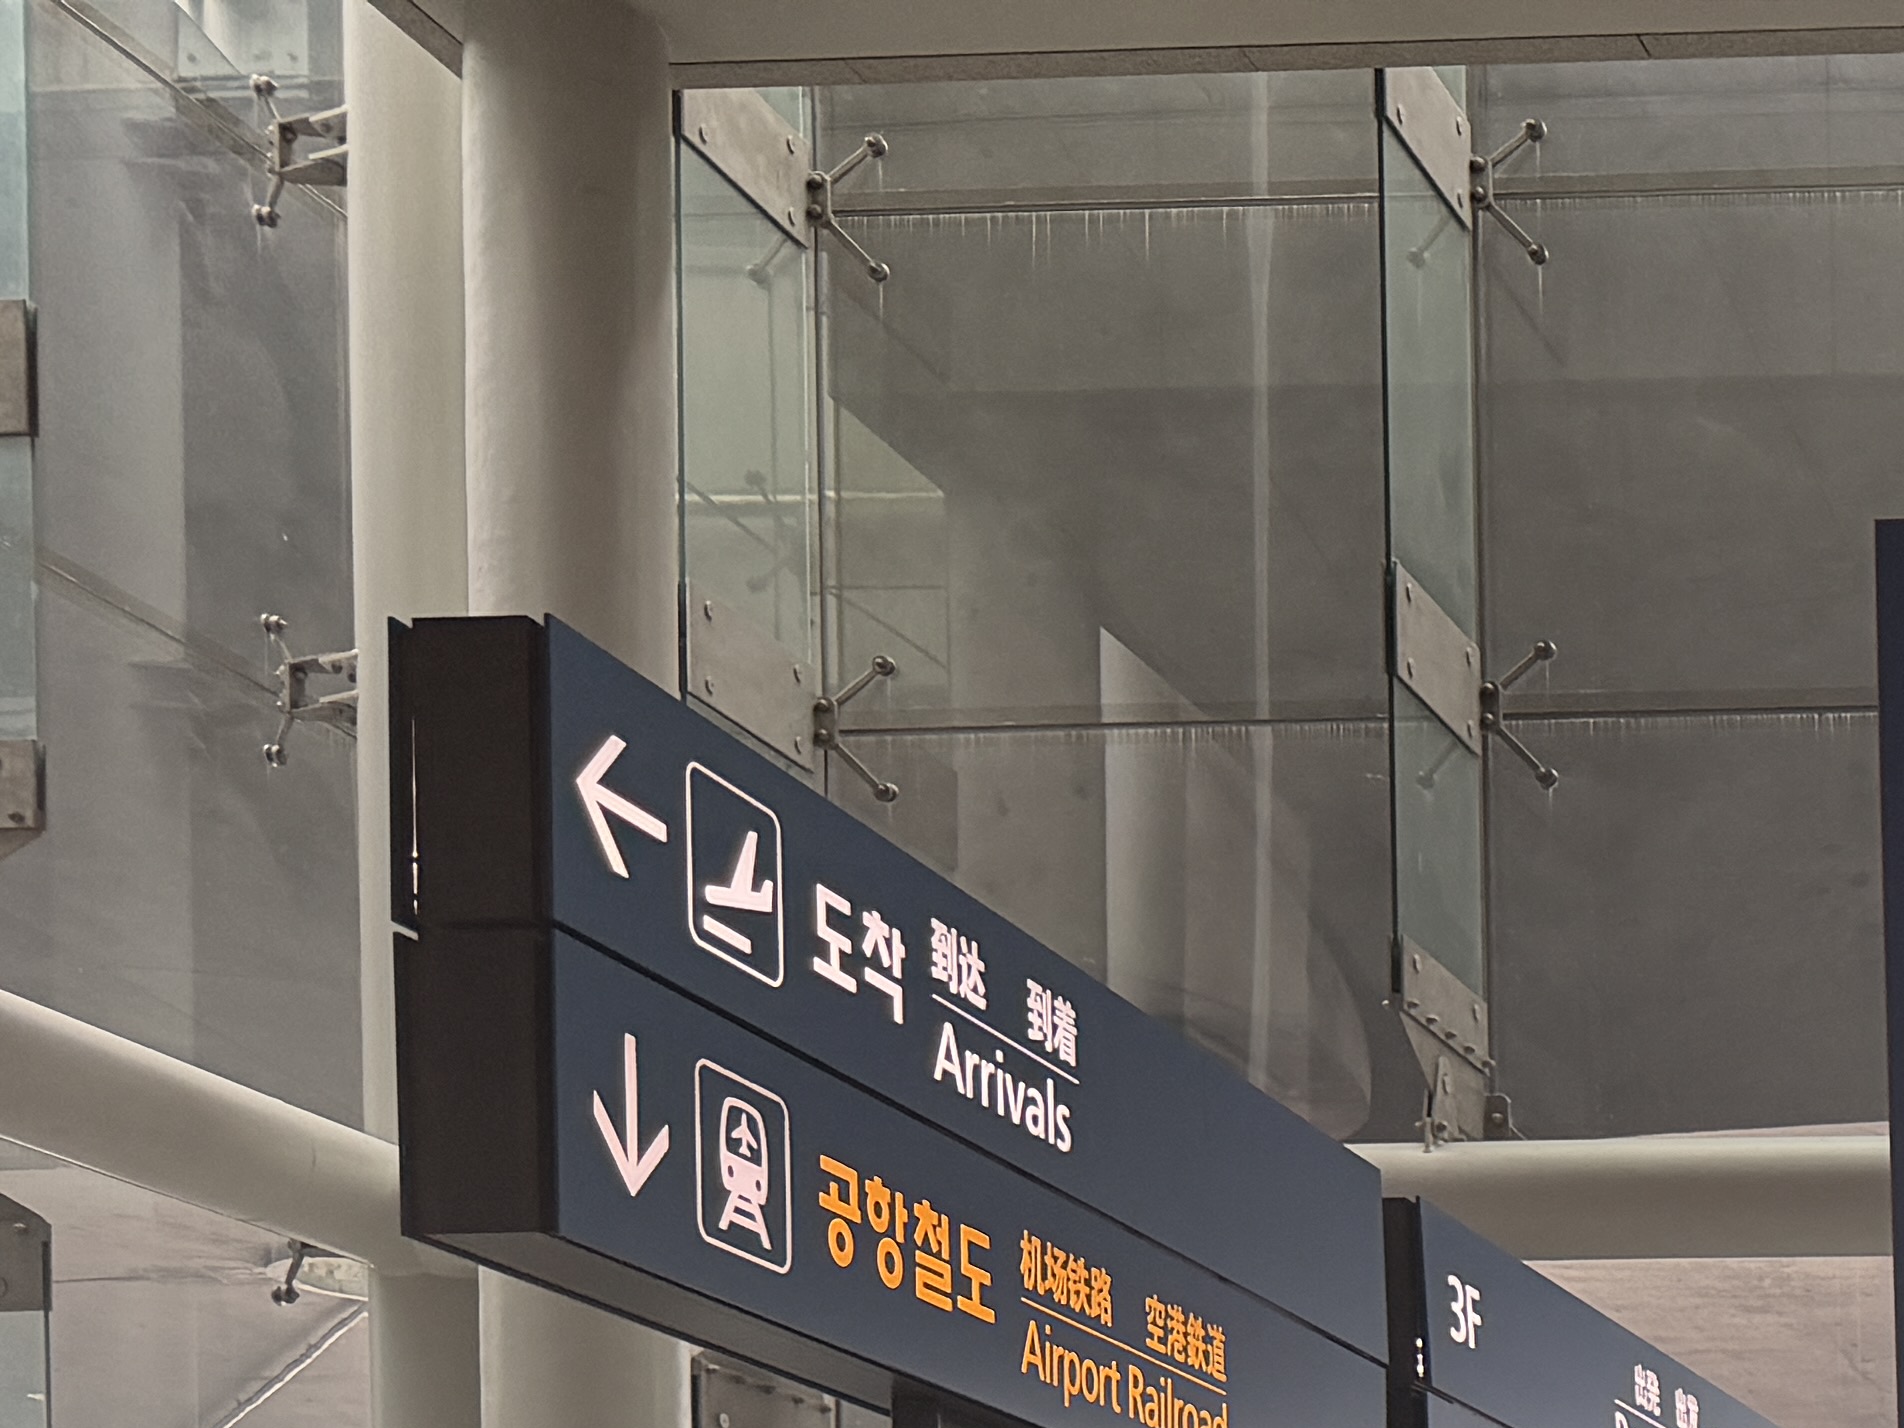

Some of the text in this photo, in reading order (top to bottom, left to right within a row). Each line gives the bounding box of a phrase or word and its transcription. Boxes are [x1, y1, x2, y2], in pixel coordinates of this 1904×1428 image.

[812, 882, 907, 1026] 도착
[929, 916, 1079, 1068] 到达 到着
[932, 1022, 1075, 1154] Arrivals
[817, 1153, 997, 1325] 공항철도
[1018, 1229, 1227, 1384] 机场铁路 空港鉄道
[1020, 1319, 1122, 1416] Airport
[1446, 1274, 1483, 1349] 3F
